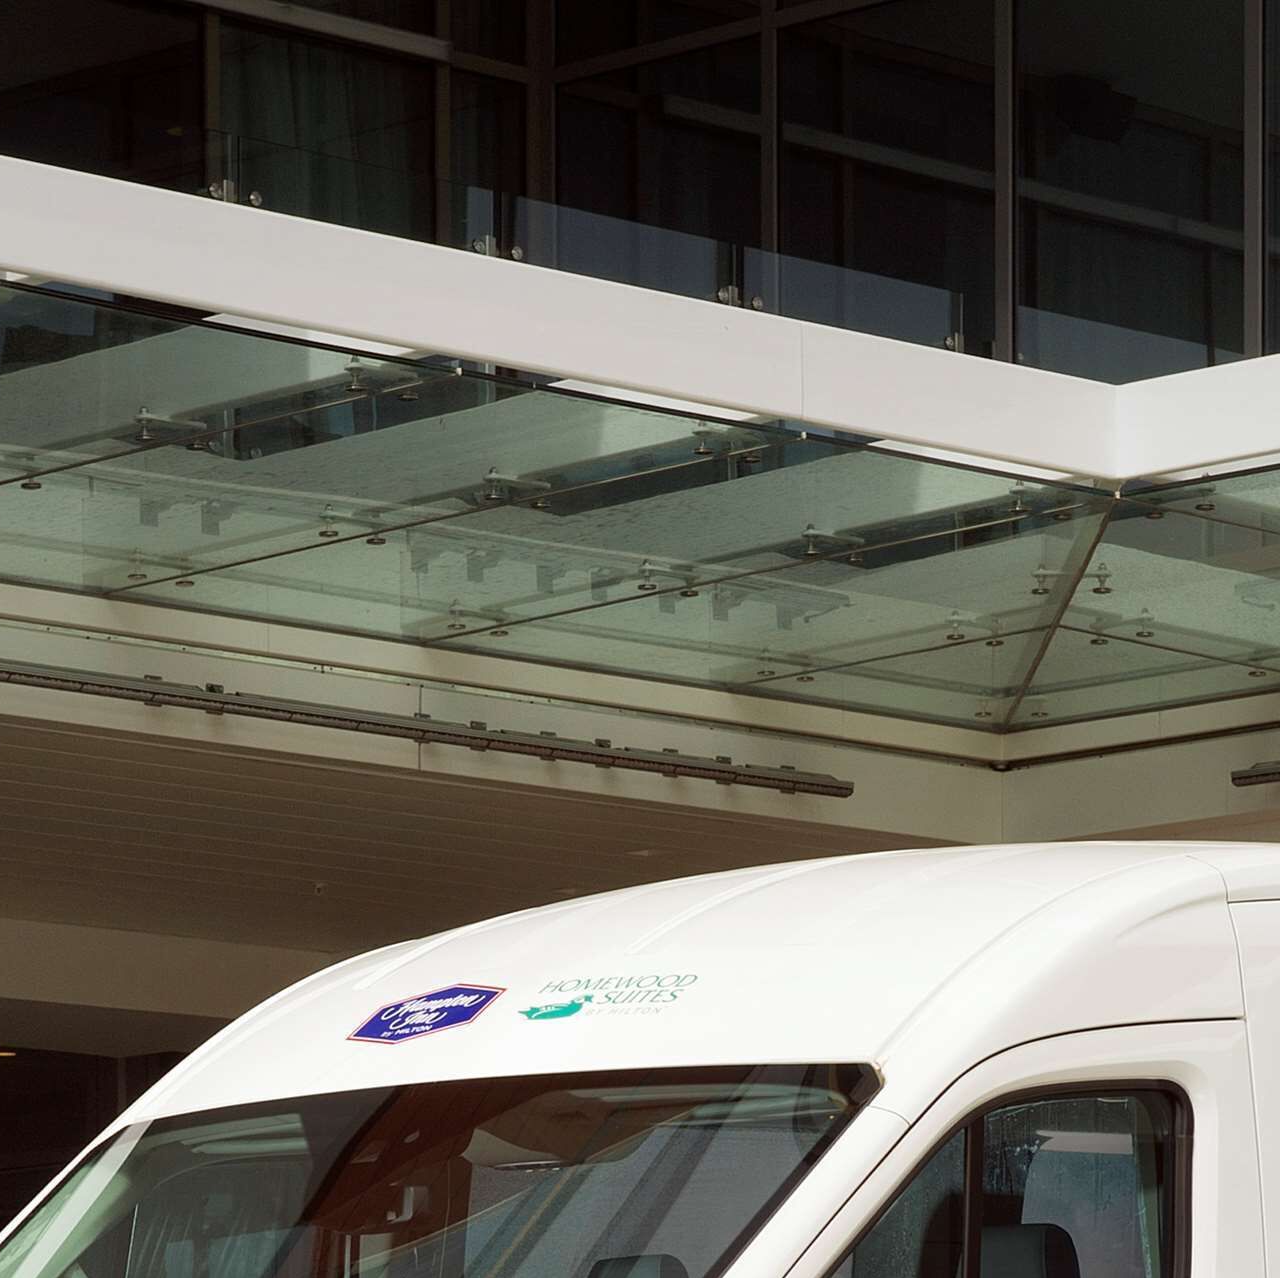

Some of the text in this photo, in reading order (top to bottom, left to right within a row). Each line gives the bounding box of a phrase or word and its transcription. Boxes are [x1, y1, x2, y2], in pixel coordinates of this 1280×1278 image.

[537, 974, 699, 994] HOMEWOOD
[596, 988, 685, 1005] SUITES
[380, 993, 486, 1021] Hampton
